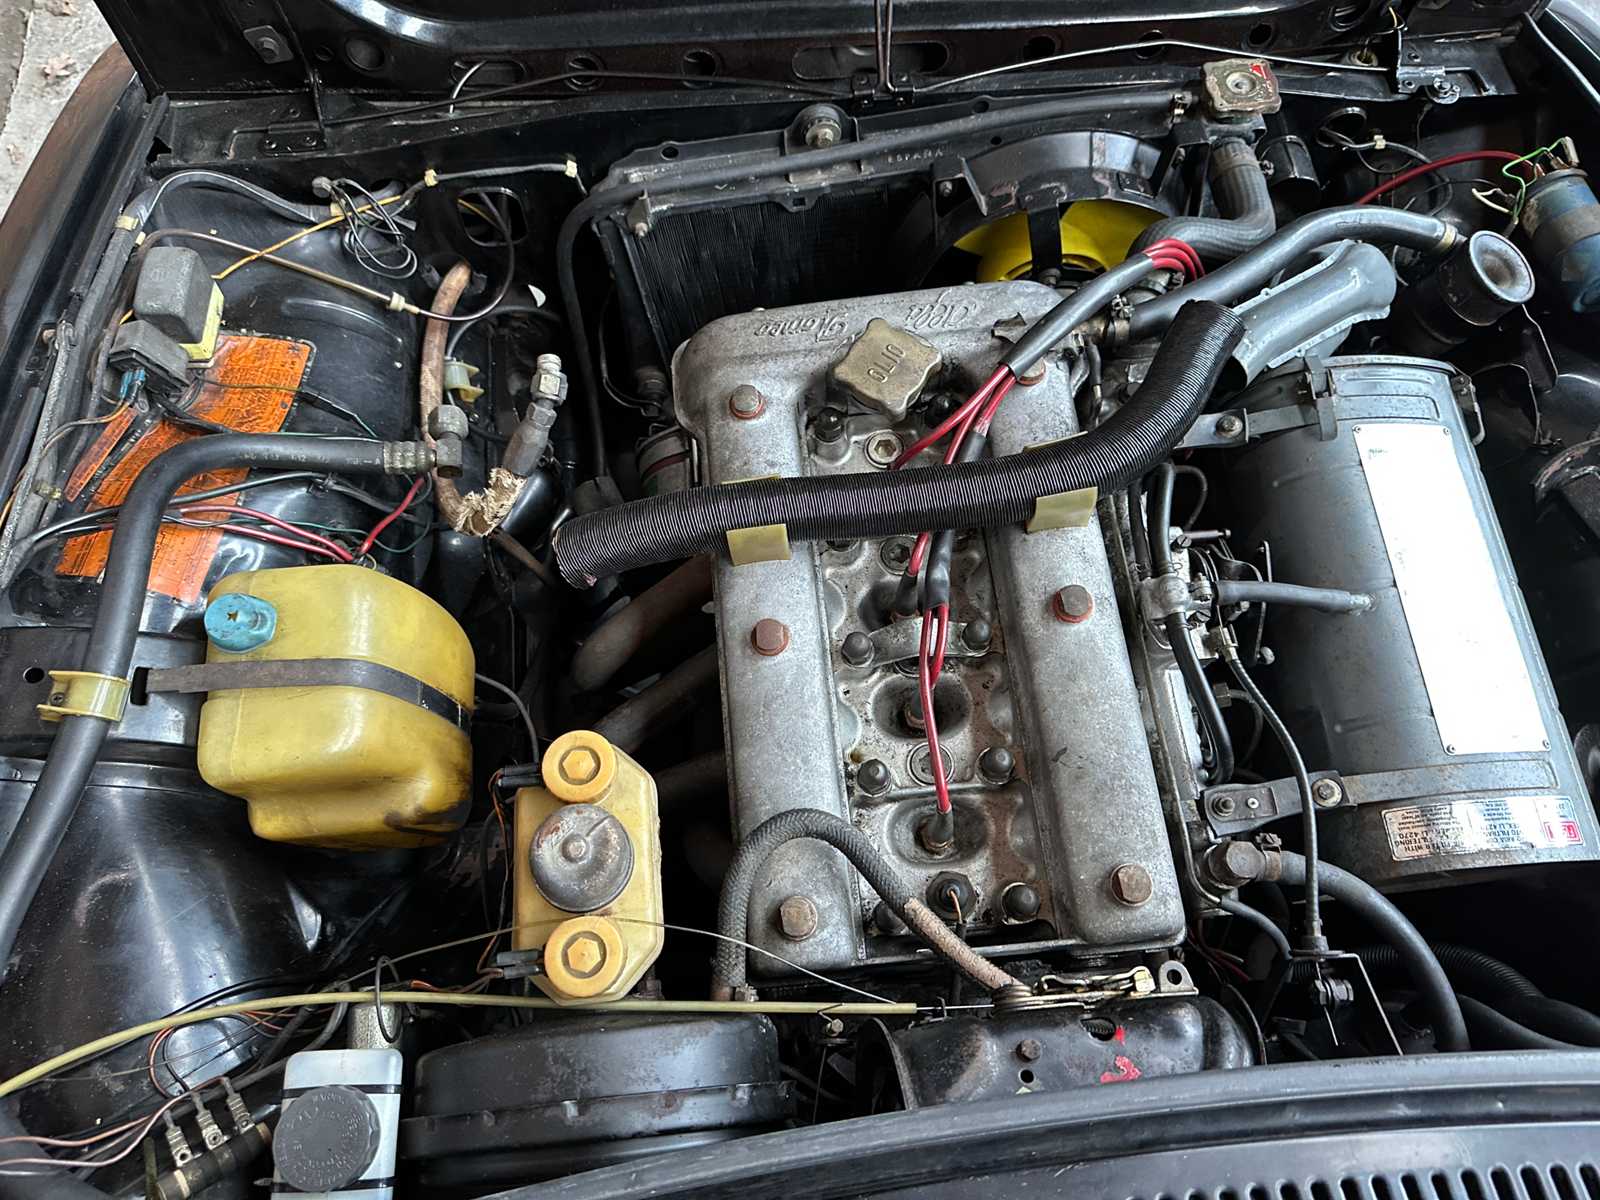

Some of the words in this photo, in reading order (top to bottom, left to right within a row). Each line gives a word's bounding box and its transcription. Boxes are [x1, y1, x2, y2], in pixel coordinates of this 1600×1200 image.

[753, 310, 848, 343] Romeo
[904, 288, 977, 330] Alfa
[867, 344, 905, 384] OLIO
